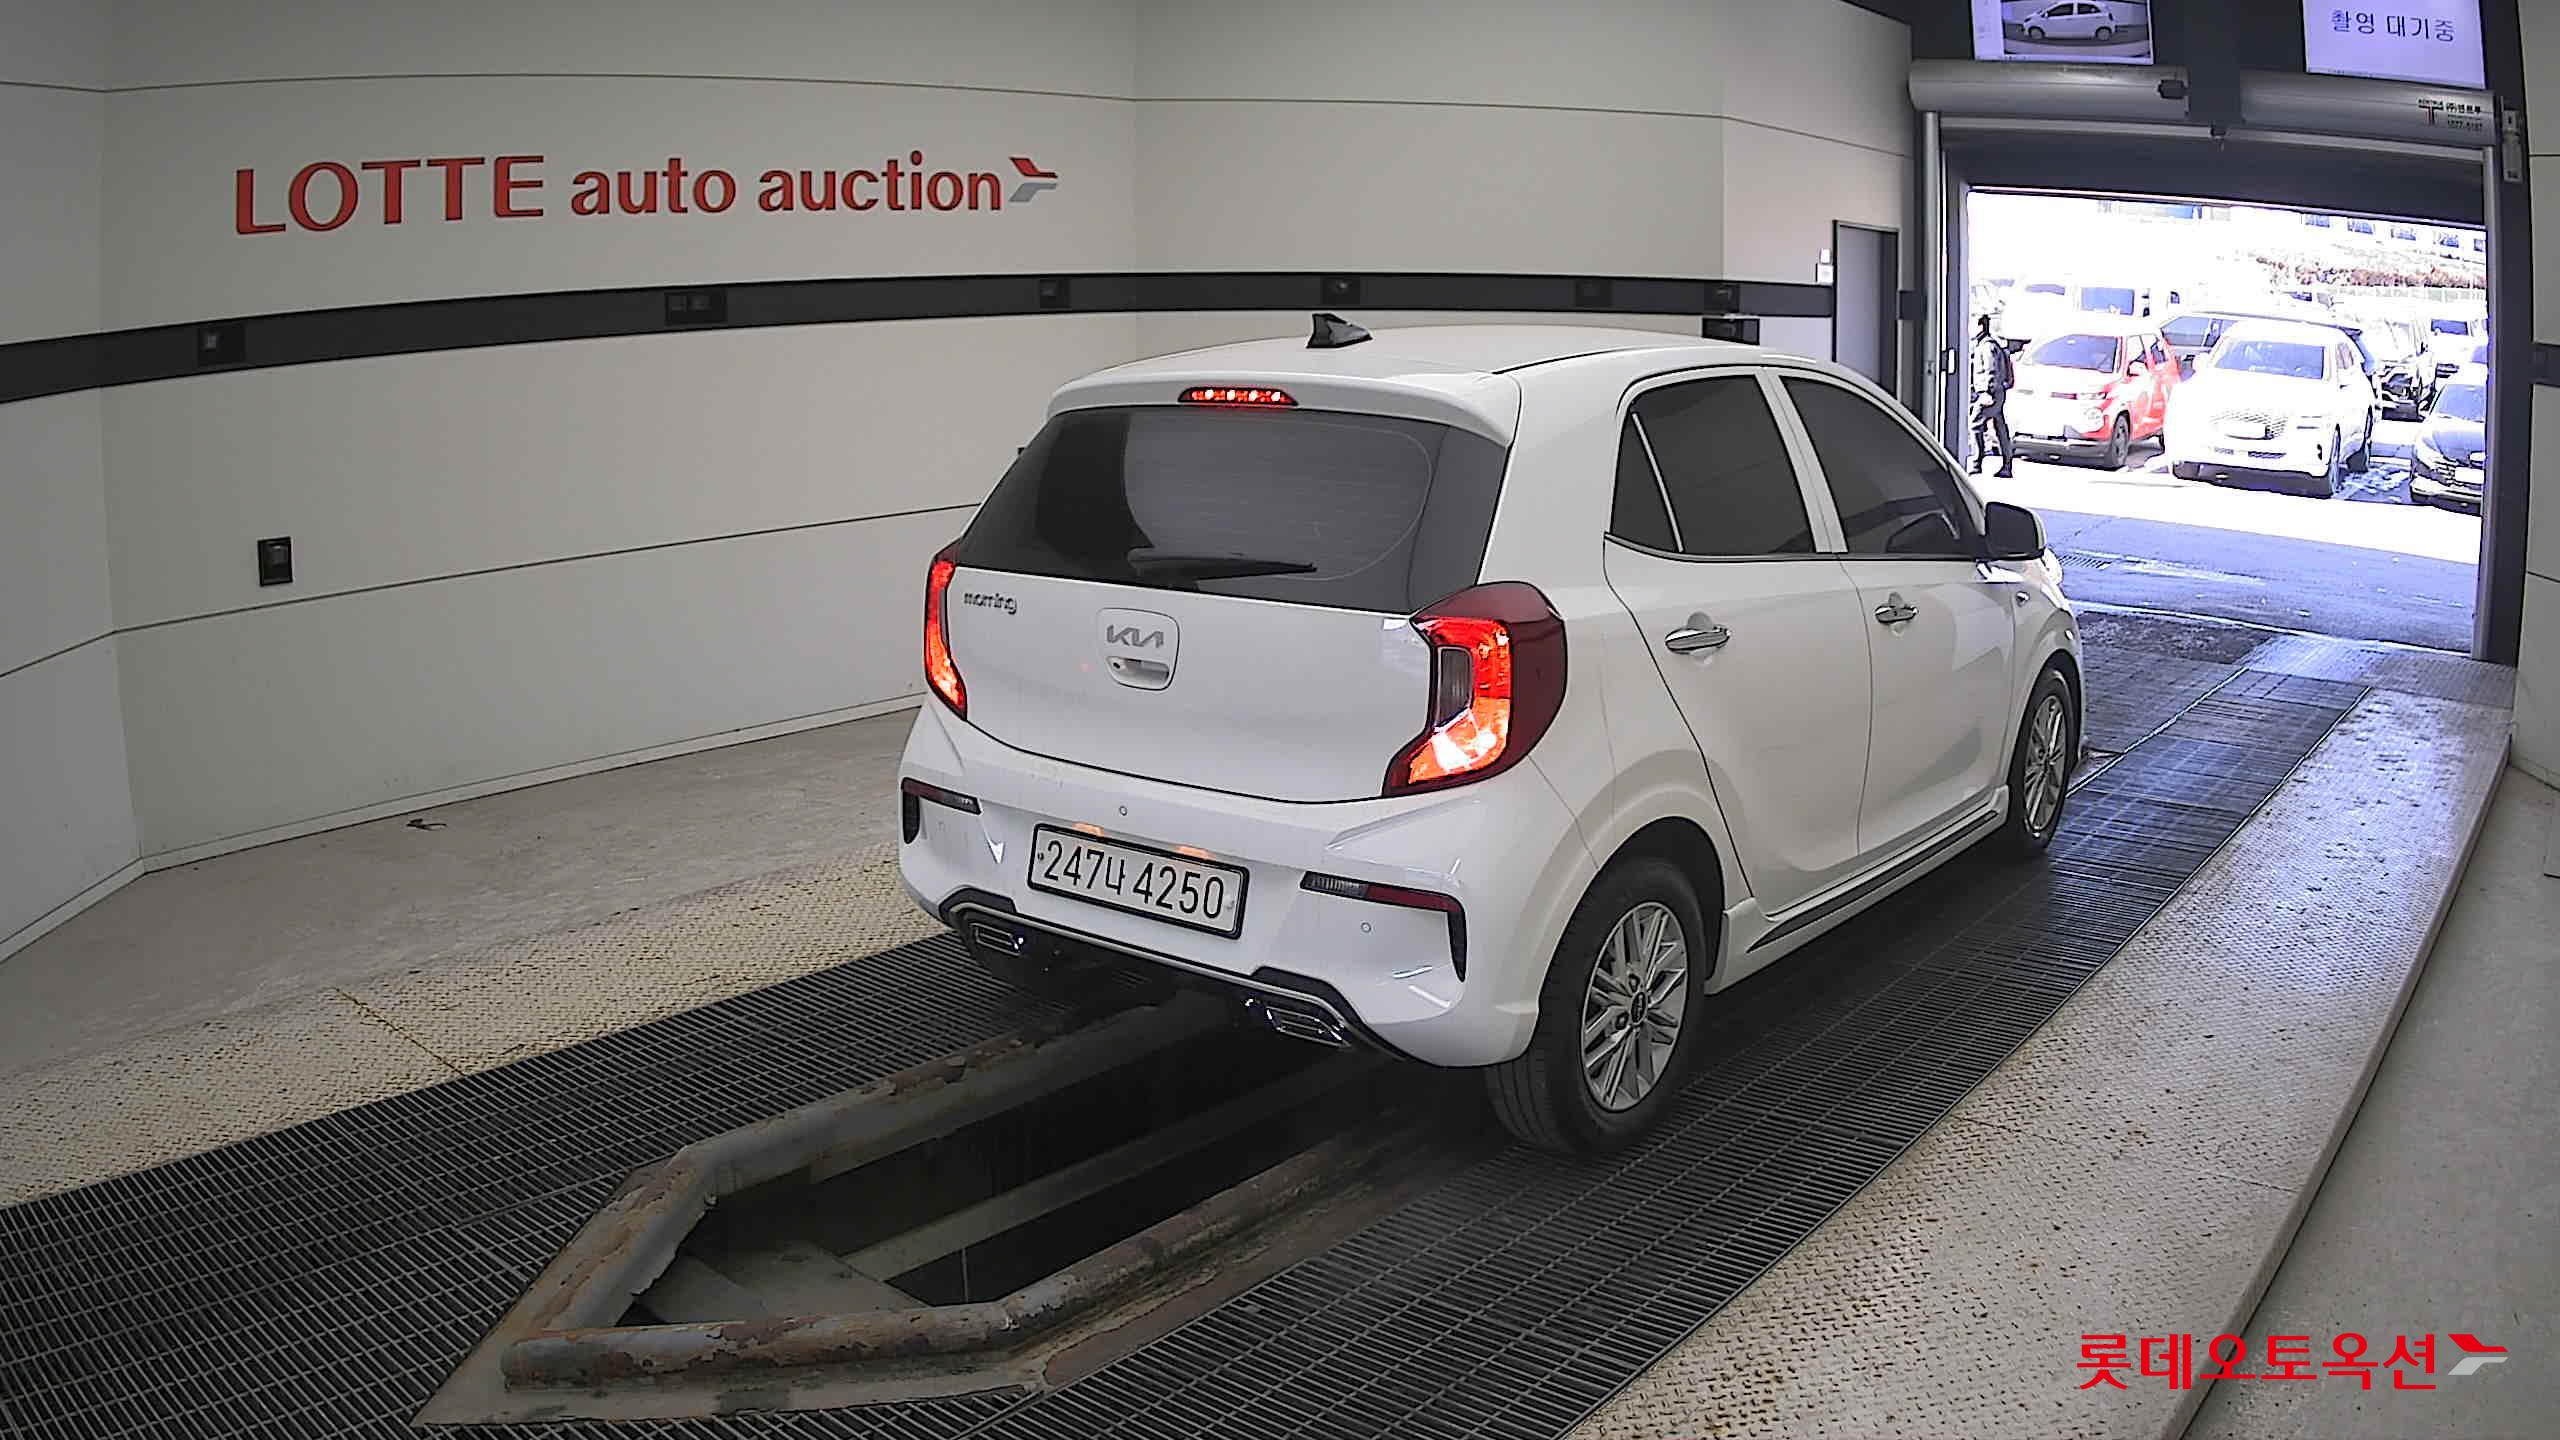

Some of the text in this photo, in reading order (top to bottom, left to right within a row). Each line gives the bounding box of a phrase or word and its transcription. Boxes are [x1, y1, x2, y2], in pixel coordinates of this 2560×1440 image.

[2331, 9, 2455, 42] 촬영 대기중
[236, 151, 1004, 234] LOTTE auto auction
[963, 592, 1018, 616] morning
[1132, 862, 1224, 919] 4250
